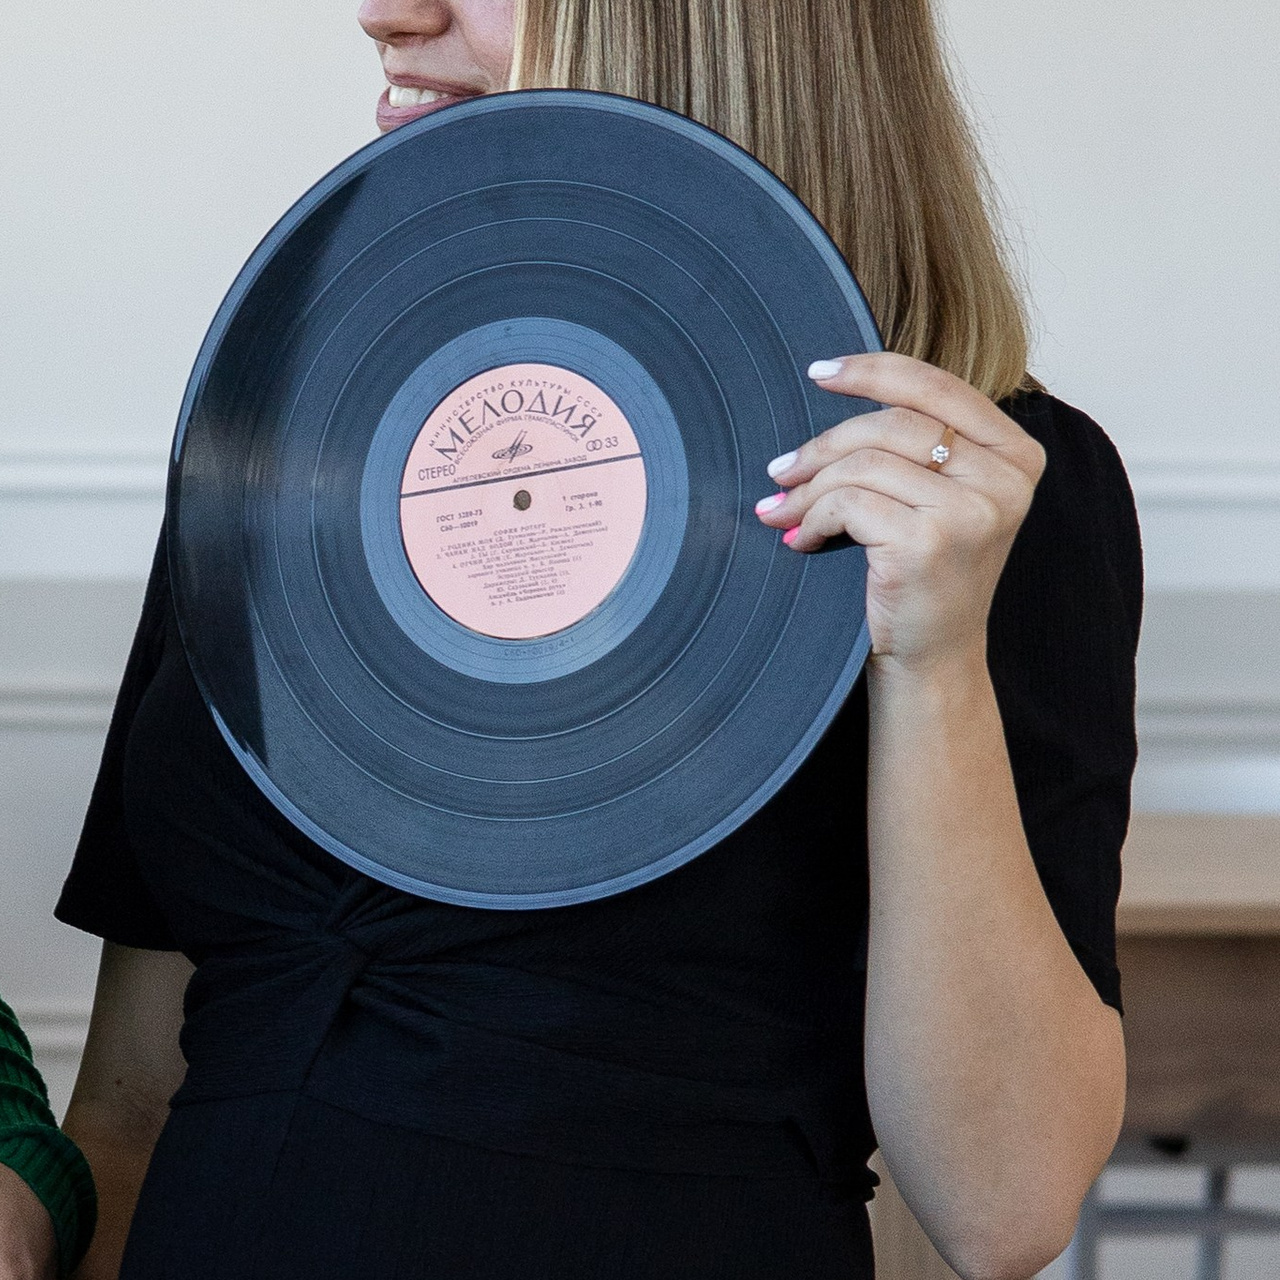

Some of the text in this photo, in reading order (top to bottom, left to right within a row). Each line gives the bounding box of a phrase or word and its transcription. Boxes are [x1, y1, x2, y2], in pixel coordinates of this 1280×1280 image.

[428, 379, 603, 448] МИНИСТЕРСТВО КУЛЬТУРЫ СССР
[435, 389, 597, 461] МЕЛОДИЯ
[605, 436, 619, 449] 33
[418, 464, 456, 481] СТЕРЕО
